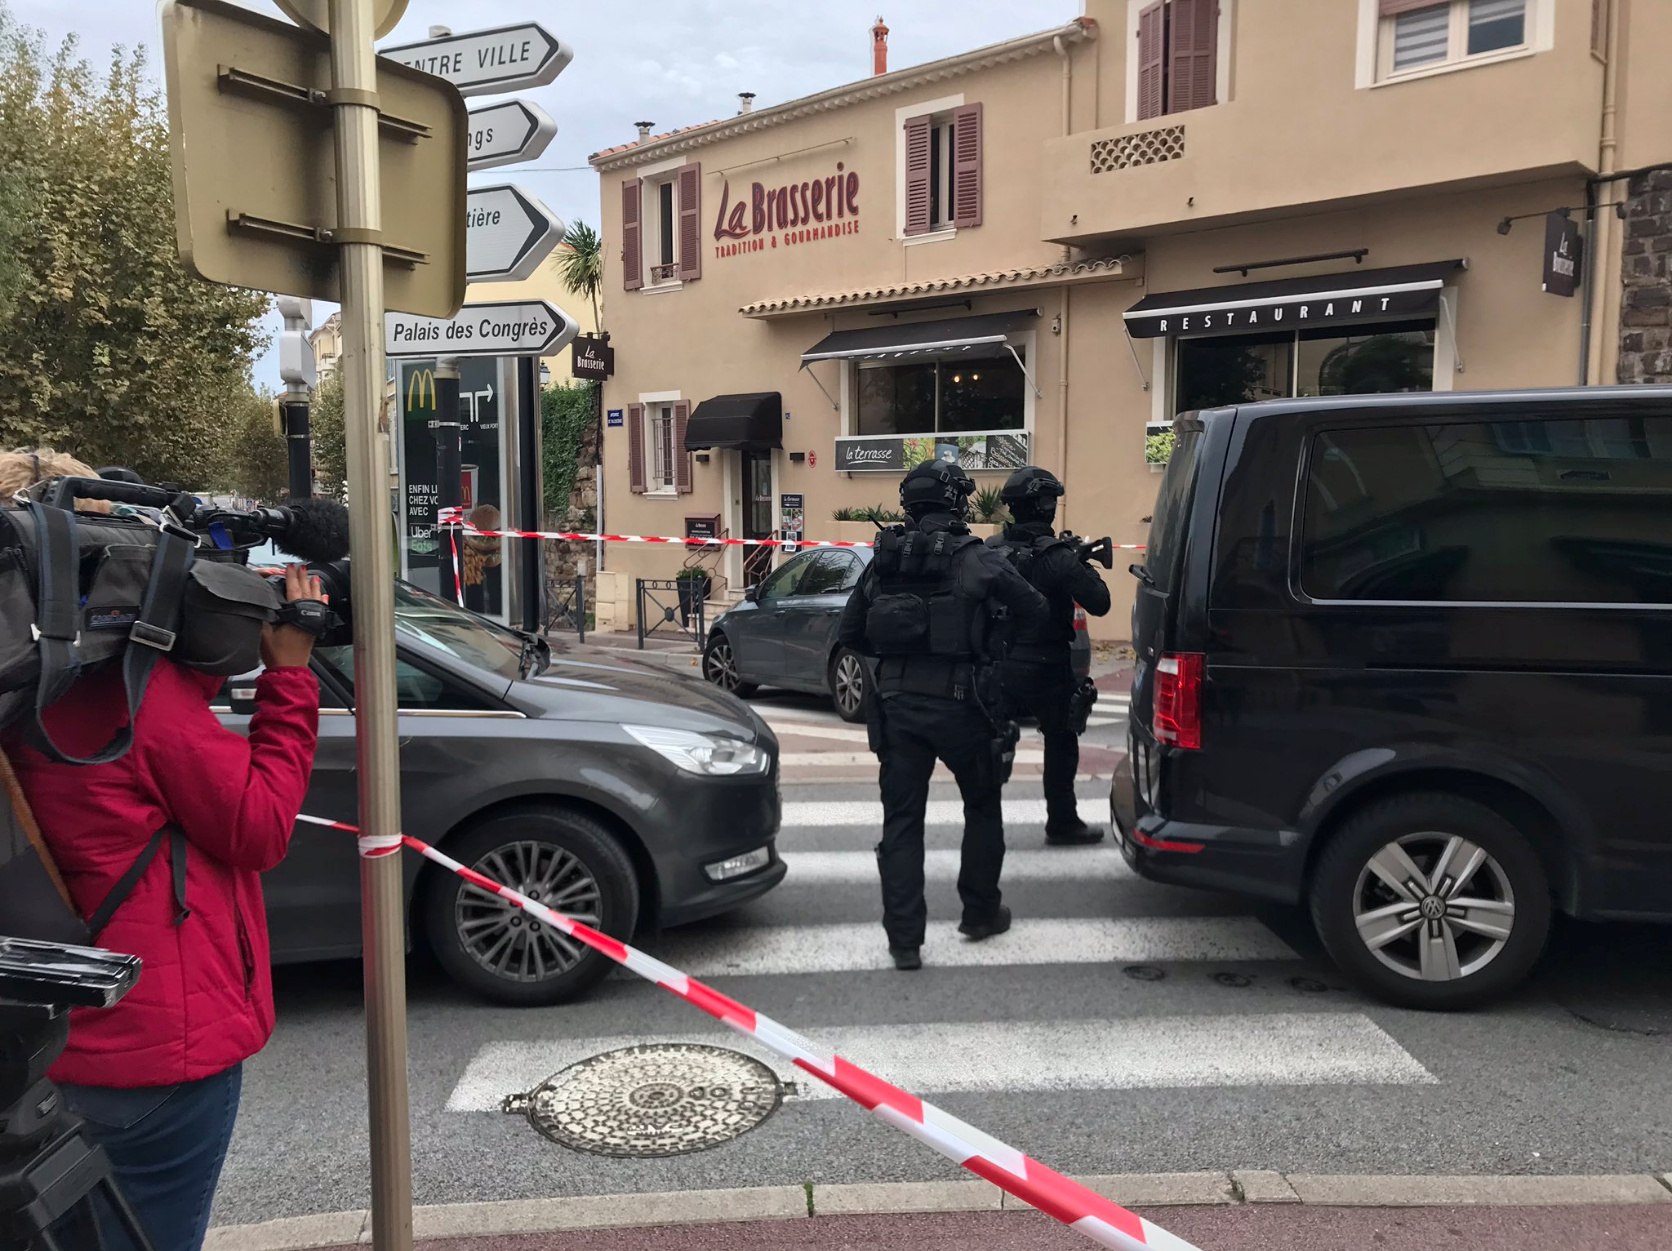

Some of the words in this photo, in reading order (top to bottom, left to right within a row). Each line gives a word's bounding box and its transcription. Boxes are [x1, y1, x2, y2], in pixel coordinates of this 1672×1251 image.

[404, 52, 463, 75] NTRE
[478, 41, 531, 69] VILLE
[467, 128, 494, 151] ngs
[714, 178, 751, 242] La
[752, 161, 860, 235] Brasserie
[466, 207, 501, 228] tière
[715, 238, 764, 259] TRADITION
[771, 235, 777, 249] &
[784, 220, 860, 246] GOURMANDISE
[1160, 297, 1390, 332] RESTAURANT
[393, 322, 440, 342] Palais
[446, 320, 474, 340] des
[479, 317, 548, 342] Congrès
[585, 345, 595, 359] La
[577, 355, 605, 371] Brasserie
[846, 446, 854, 460] la
[854, 445, 892, 460] terrasse
[408, 484, 430, 494] ENFIN
[408, 495, 429, 505] CHEZ
[429, 495, 439, 505] VO
[408, 506, 429, 516] AVEC
[411, 525, 432, 539] Uber
[411, 539, 433, 552] Eats
